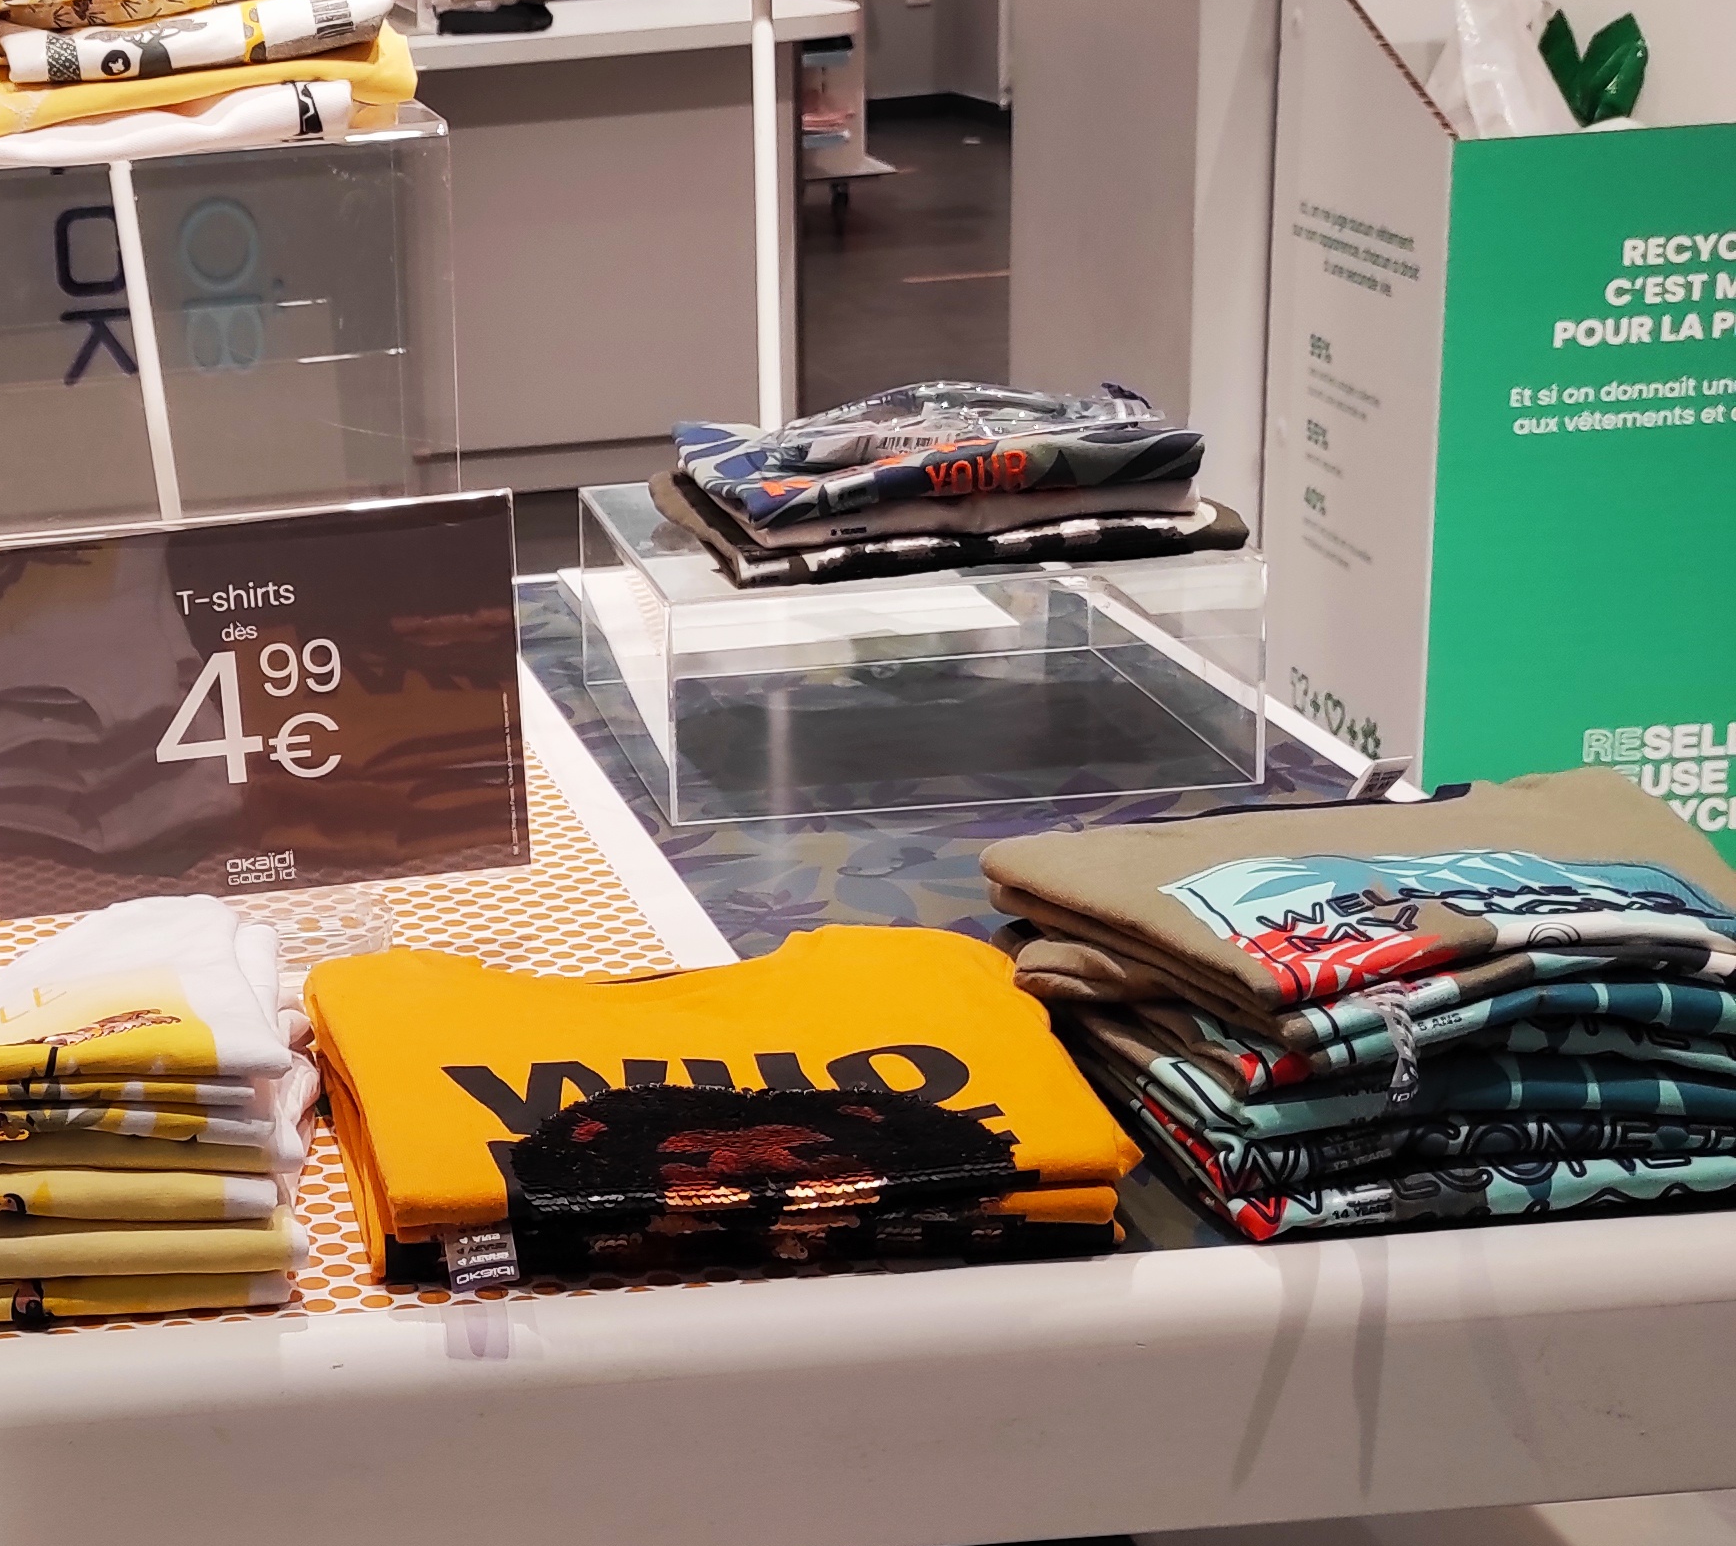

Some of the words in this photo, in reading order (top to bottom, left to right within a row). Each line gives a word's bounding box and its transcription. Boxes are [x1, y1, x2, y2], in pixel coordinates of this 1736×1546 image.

[1553, 315, 1653, 348] POUR
[1659, 313, 1704, 342] LA
[1509, 386, 1532, 408] Et
[1537, 383, 1558, 405] si
[1562, 385, 1595, 404] on
[1600, 374, 1696, 403] donnait
[1513, 416, 1559, 436] aux
[1564, 405, 1695, 432] vêtements
[1700, 403, 1725, 424] et
[925, 449, 1027, 495] YOUR
[176, 581, 296, 616] T-shirts
[221, 621, 258, 643] dès
[156, 650, 264, 785] 4
[259, 638, 342, 698] 99
[1431, 1012, 1463, 1030] ANS
